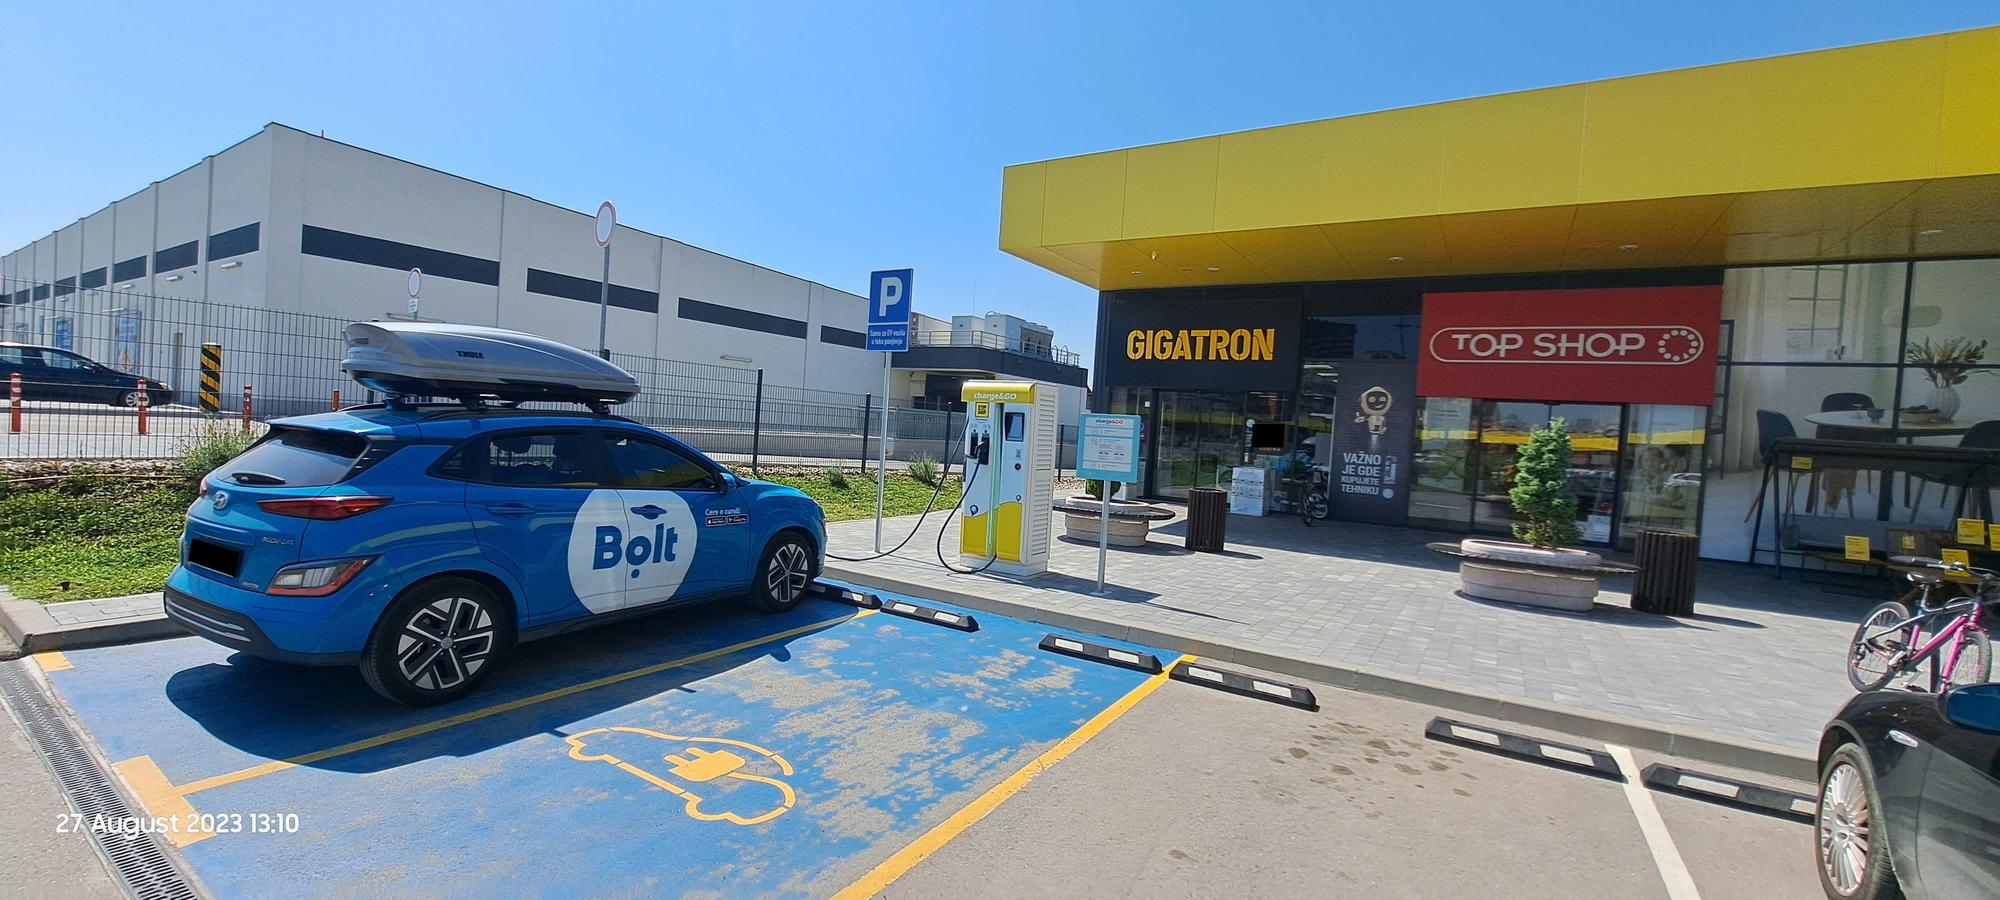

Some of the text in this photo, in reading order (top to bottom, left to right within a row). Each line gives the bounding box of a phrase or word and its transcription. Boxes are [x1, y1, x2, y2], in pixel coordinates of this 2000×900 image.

[879, 277, 903, 316] P
[1126, 328, 1275, 361] GIGATRON
[1451, 332, 1646, 358] TOP SHOP
[456, 350, 485, 359] THULE
[973, 391, 1017, 401] charge&GO
[1343, 450, 1381, 466] VAŽNO
[1341, 464, 1381, 477] JE GDE
[1340, 475, 1380, 486] KUPUJETE
[1340, 484, 1380, 496] TEHNIKU
[704, 508, 719, 516] Cere
[592, 522, 679, 579] Bolt
